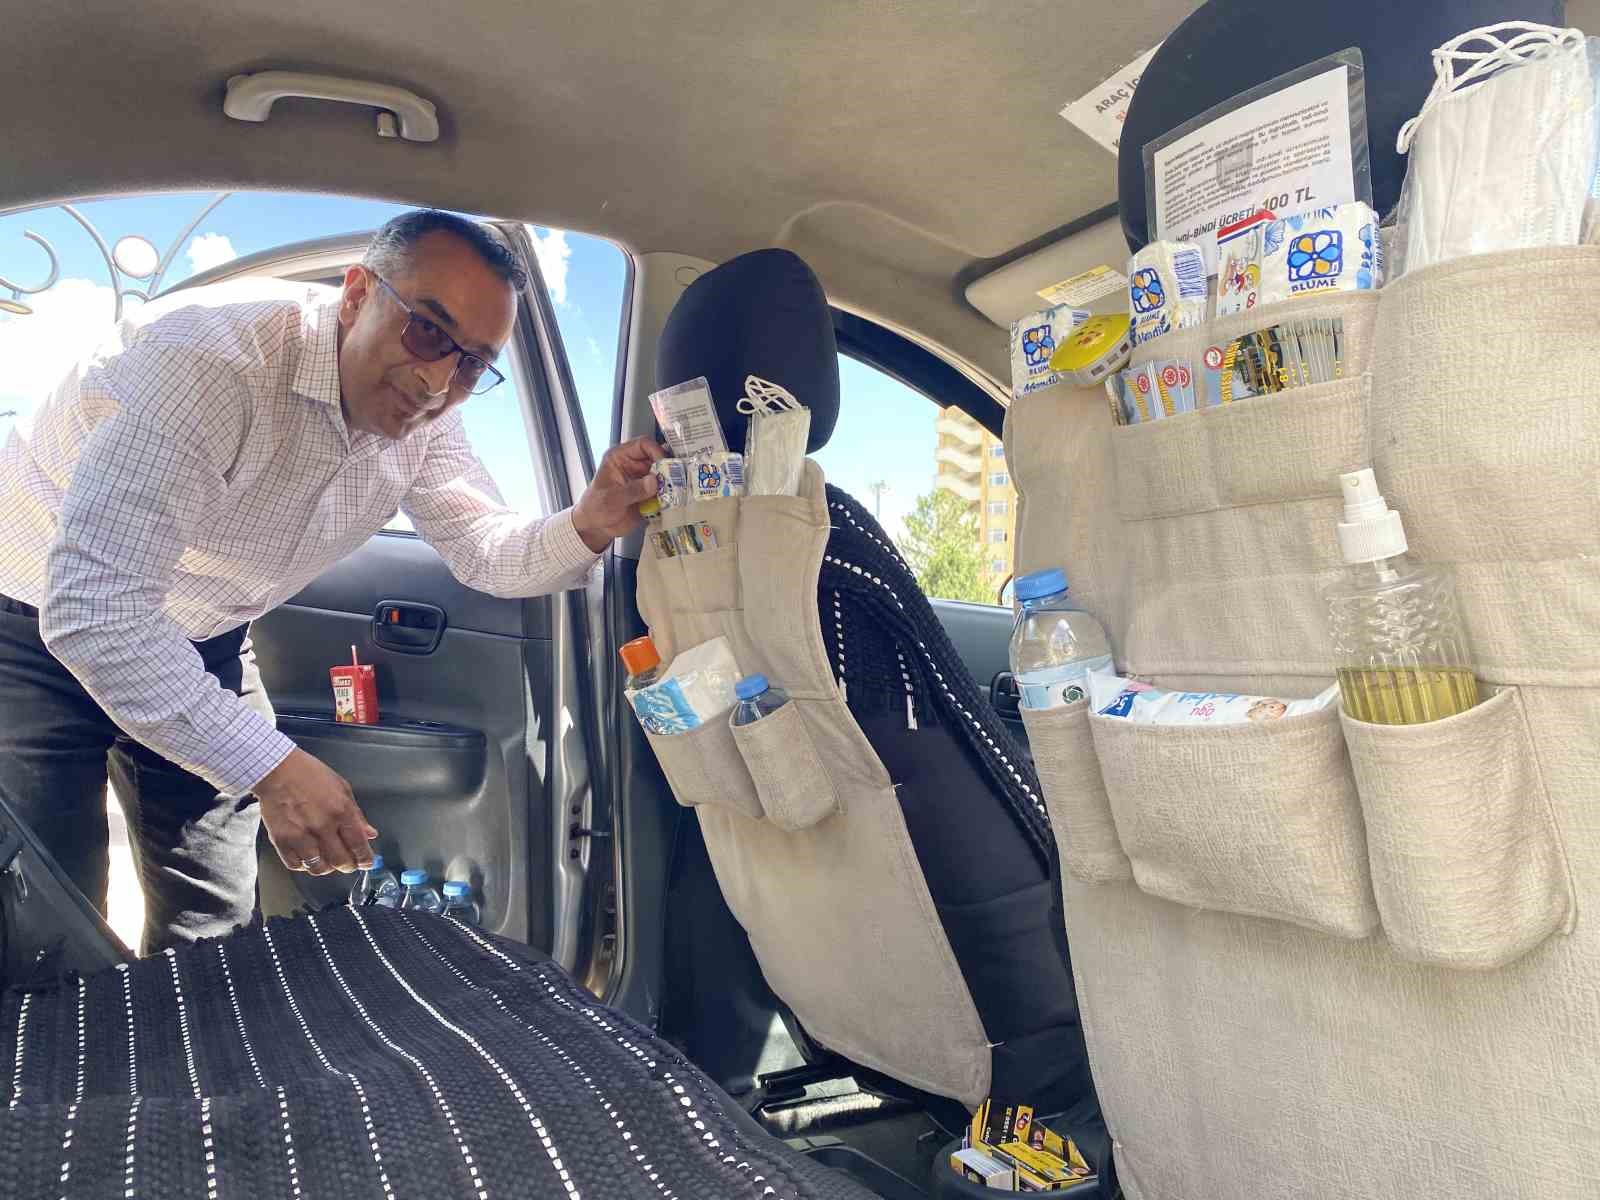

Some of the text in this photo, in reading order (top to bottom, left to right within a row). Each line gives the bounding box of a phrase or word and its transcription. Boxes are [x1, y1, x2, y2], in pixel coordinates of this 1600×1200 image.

[1262, 193, 1289, 211] 100
[1295, 186, 1316, 203] TL
[1291, 278, 1337, 292] BLUME
